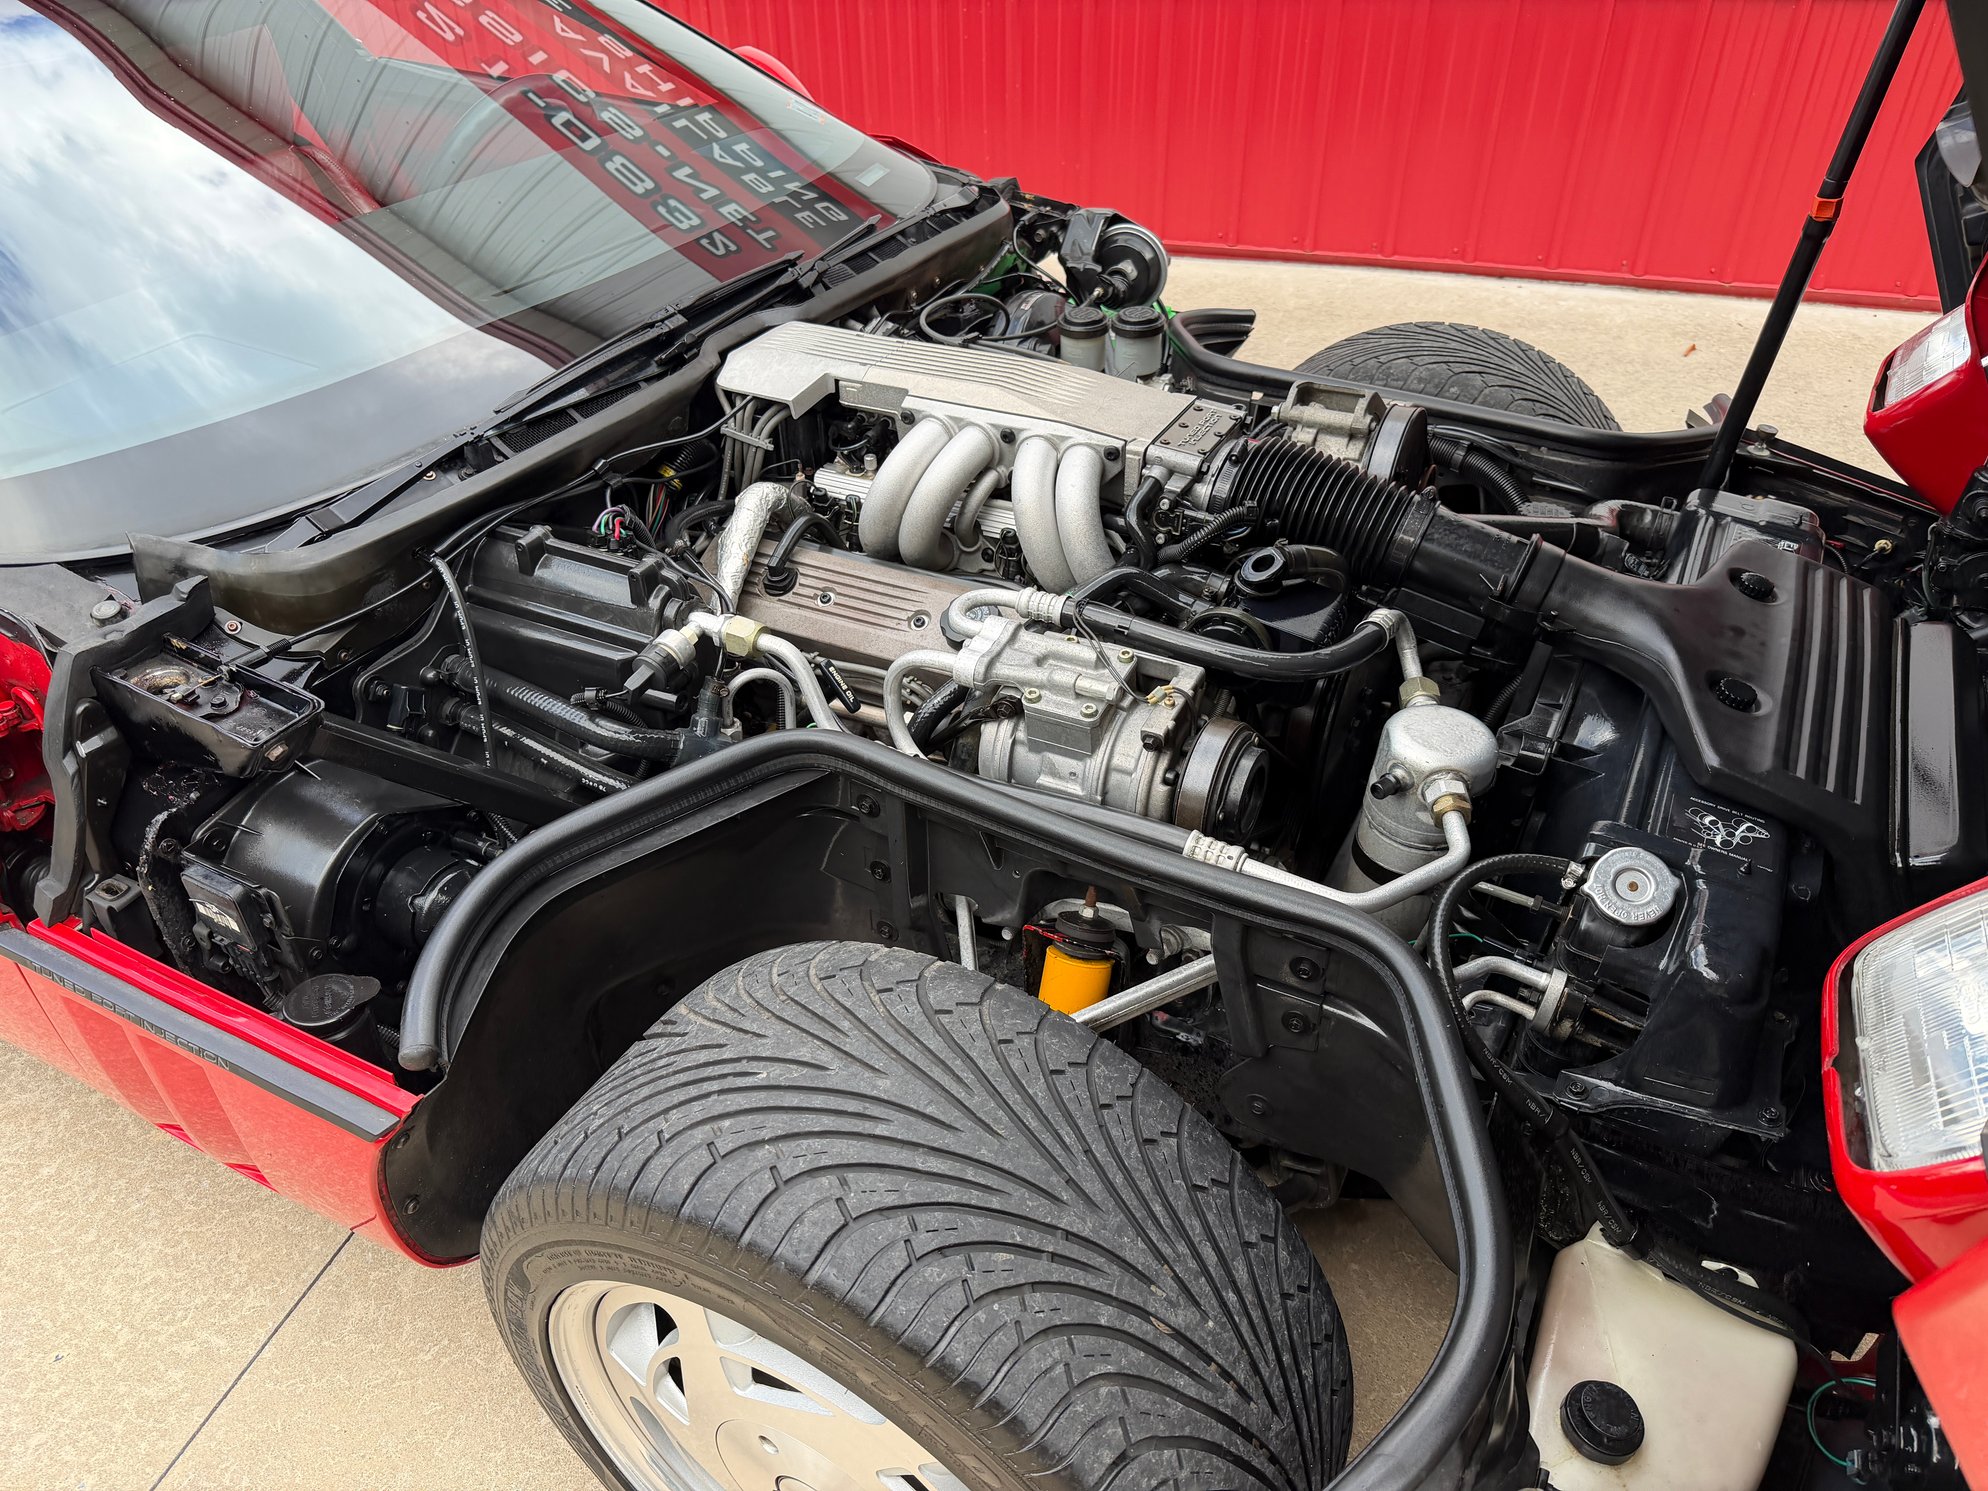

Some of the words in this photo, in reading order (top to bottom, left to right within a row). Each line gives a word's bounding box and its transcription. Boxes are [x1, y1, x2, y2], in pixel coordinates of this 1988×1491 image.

[1178, 426, 1201, 446] TUNED
[1594, 883, 1607, 902] HOT
[1604, 901, 1629, 919] OPEN
[1632, 905, 1663, 920] NEVER
[32, 963, 86, 997] TUNED
[141, 1019, 230, 1071] INJECTION
